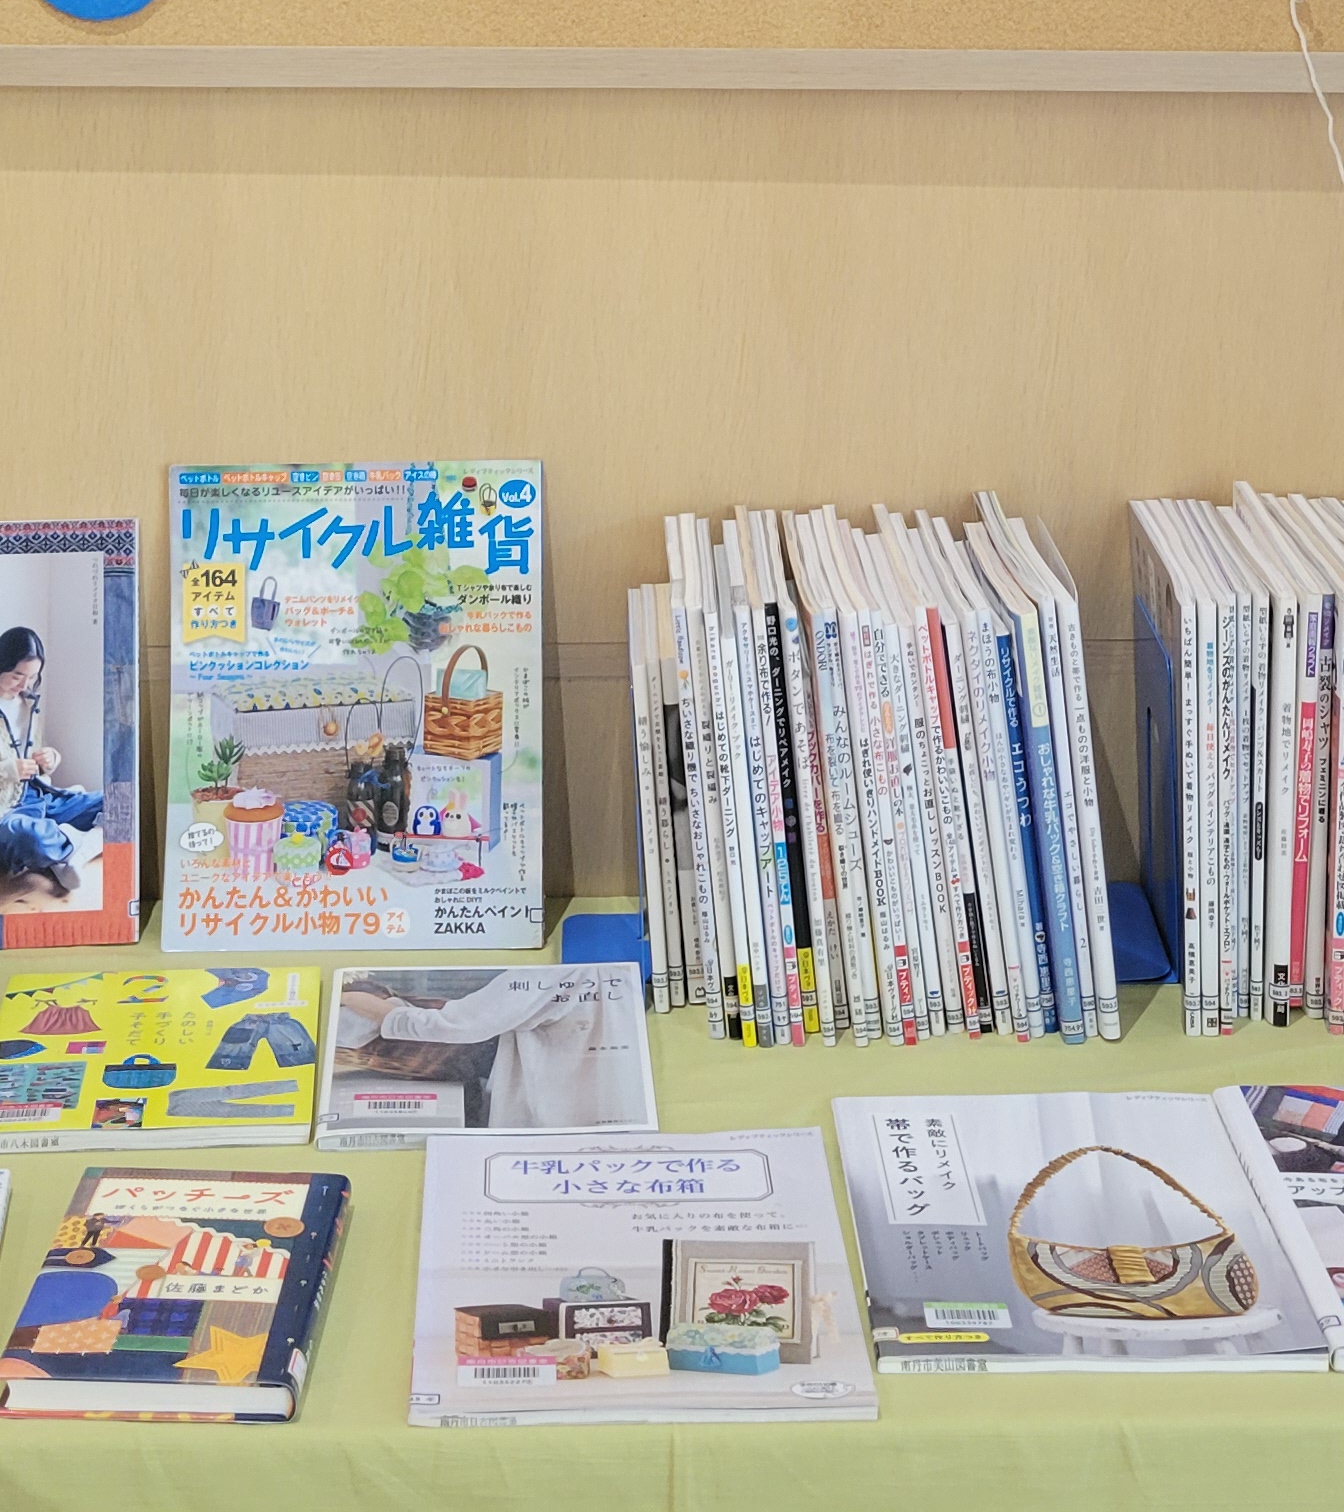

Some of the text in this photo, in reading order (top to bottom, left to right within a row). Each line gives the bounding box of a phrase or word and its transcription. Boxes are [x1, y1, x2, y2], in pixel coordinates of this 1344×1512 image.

[501, 483, 533, 504] Vol.4
[181, 490, 535, 575] リサイクル雑貨
[191, 591, 235, 601] アイテム
[457, 594, 532, 606] ダンボール織り
[193, 606, 234, 616] すべて
[190, 619, 237, 629] 作り方つき
[284, 618, 327, 628] ウォレット
[189, 659, 309, 672] ピンクッションコレクション
[873, 628, 891, 699] 自分でできる
[981, 622, 1000, 704] まほうの布小物
[966, 630, 997, 783] ネクタイのリメイク小物
[1011, 742, 1033, 828] エコうつわ
[178, 885, 389, 909] かんたん＆かわいい
[179, 911, 381, 936] リサイクル小物79
[434, 922, 486, 935] ZAKKA
[509, 978, 623, 992] 刺しゅうで
[551, 991, 624, 1003] お直し
[153, 1011, 173, 1046] 手づくり
[178, 1011, 199, 1046] たのしい
[925, 1117, 957, 1192] 素敵にリメイク
[511, 1157, 742, 1176] 牛乳パックで作る
[885, 1117, 931, 1218] 帯で作るバッグ
[102, 1184, 295, 1206] パッチーズ
[552, 1177, 708, 1196] 小さな布箱
[165, 1281, 270, 1296] 佐藤まどか
